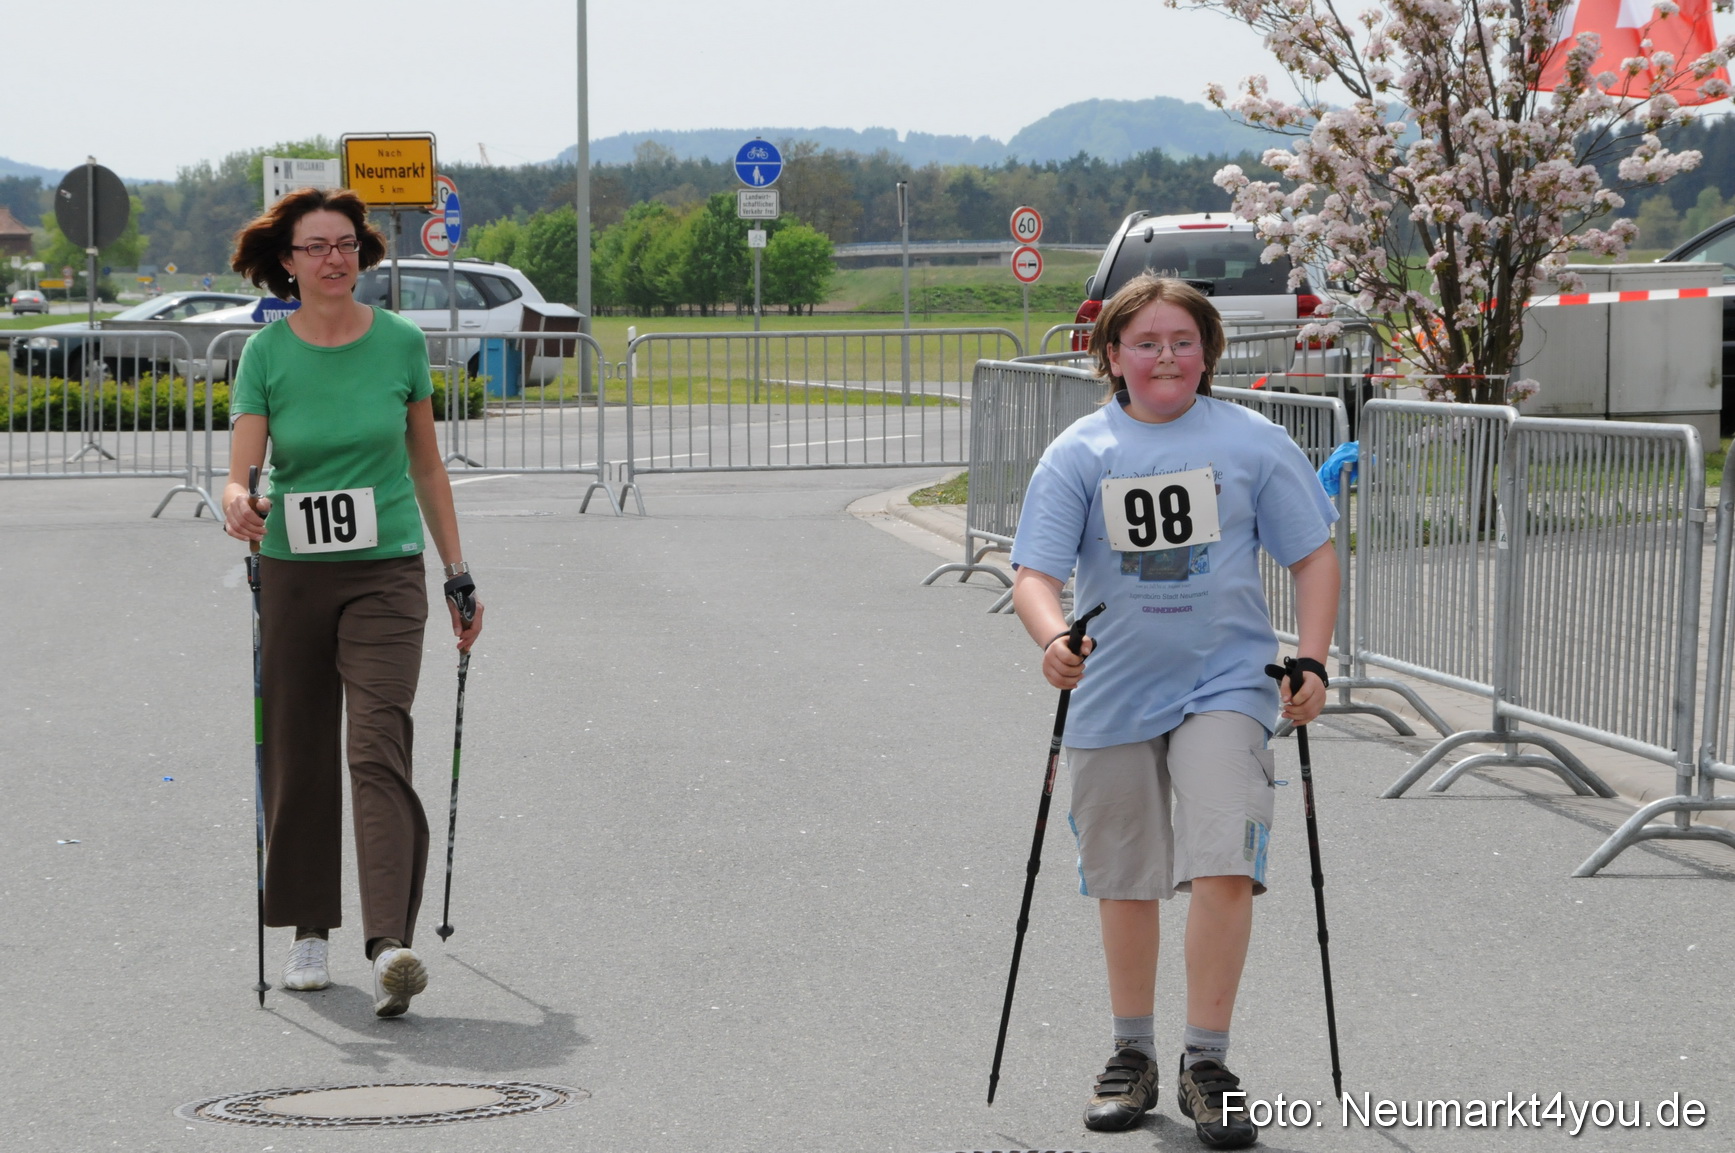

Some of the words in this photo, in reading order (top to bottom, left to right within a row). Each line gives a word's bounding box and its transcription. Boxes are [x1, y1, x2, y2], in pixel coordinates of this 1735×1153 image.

[377, 149, 402, 157] Nach
[355, 162, 426, 179] Neumarkt
[379, 184, 385, 193] 5
[392, 185, 405, 193] km
[1019, 217, 1036, 234] 60
[262, 309, 297, 323] VOLV
[299, 493, 357, 544] 119
[1124, 484, 1193, 548] 98
[1162, 592, 1179, 600] Stadt
[1180, 590, 1209, 599] Neumarkt
